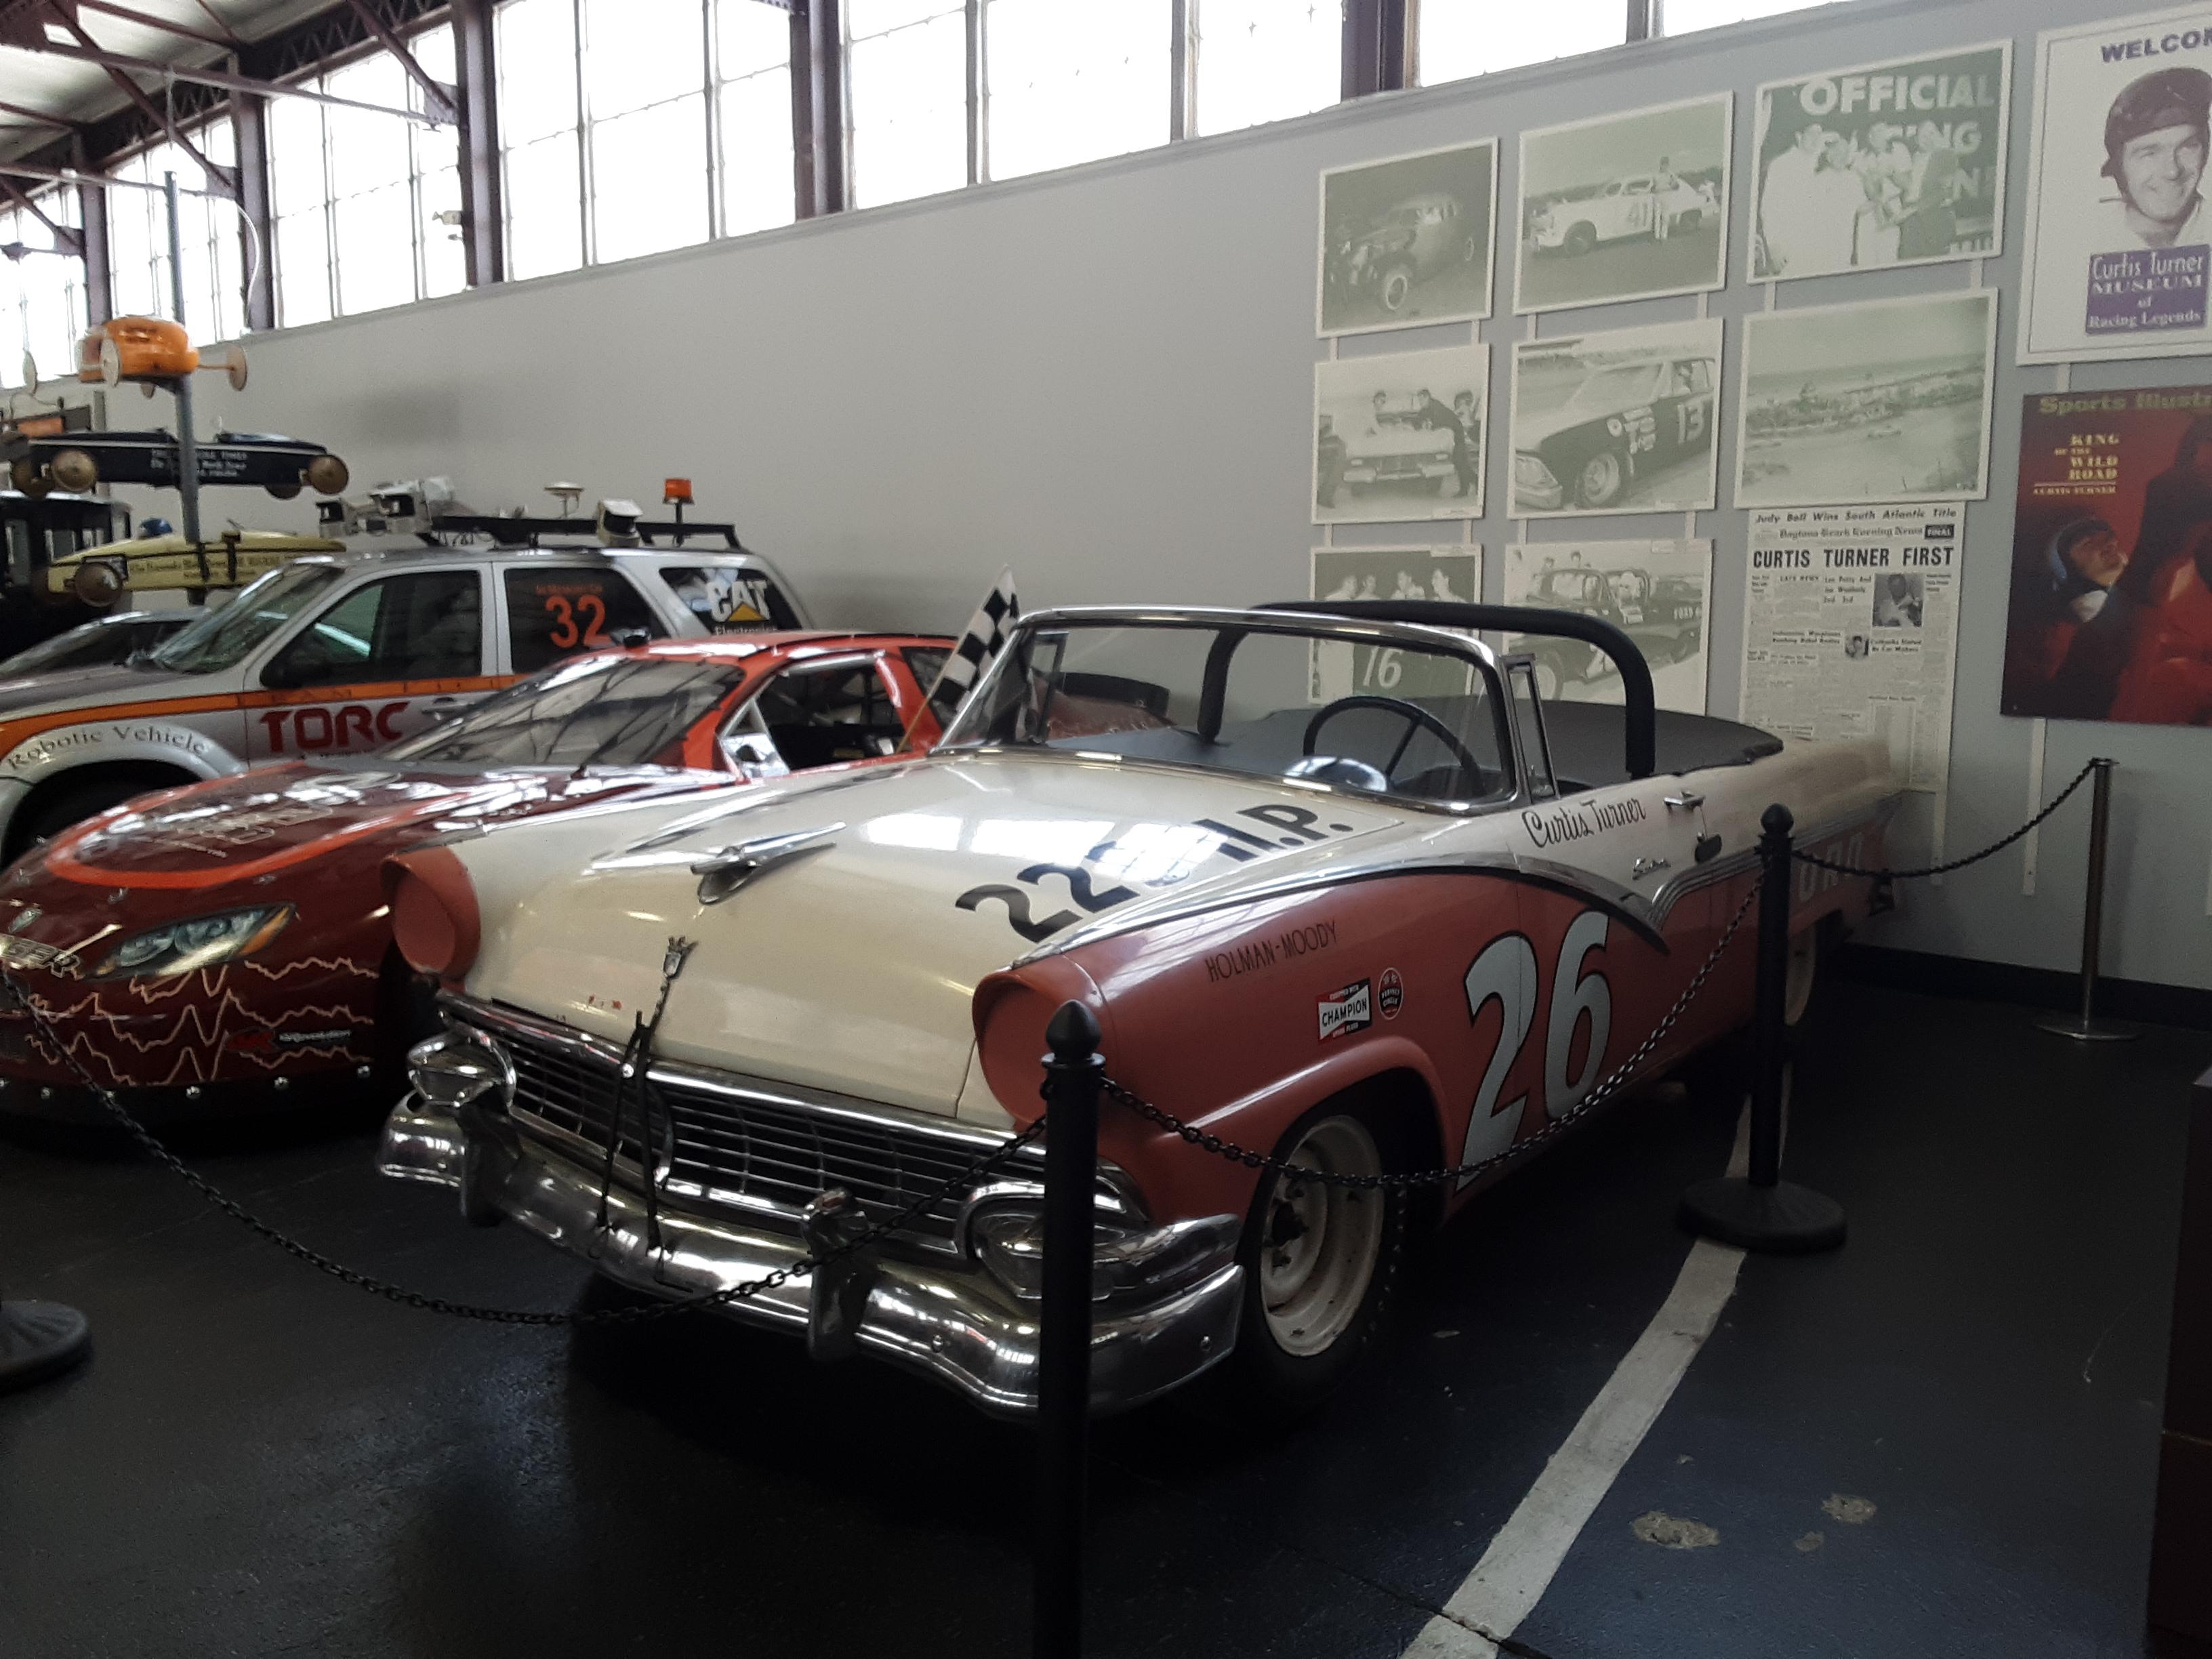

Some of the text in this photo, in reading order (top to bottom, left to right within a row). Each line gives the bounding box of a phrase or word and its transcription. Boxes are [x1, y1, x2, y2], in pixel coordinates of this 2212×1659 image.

[1800, 74, 1994, 115] OFFICIAL
[2093, 251, 2204, 281] Curtis Turner
[2092, 274, 2203, 294] MUSEUM
[2089, 309, 2201, 329] Racing Legends
[2070, 433, 2120, 445] KING
[2068, 468, 2118, 480] ROAD
[2070, 455, 2119, 467] WILD
[1755, 514, 1780, 524] Judy
[1813, 512, 1839, 521] Wins
[1845, 510, 1876, 520] South
[1882, 508, 1925, 519] Atlantic
[1933, 507, 1957, 518] Title
[1753, 547, 1954, 568] CURTIS TURNER FIRST
[706, 579, 770, 622] CAT
[545, 594, 610, 649] 32
[1362, 646, 1403, 689] 16
[260, 701, 410, 752] TORC
[8, 728, 104, 770] Robotic
[1521, 798, 1647, 848] Curtis Turner
[1204, 917, 1337, 982] HOLMAN-MOODY
[1322, 998, 1368, 1027] CHAMPION
[1454, 908, 1612, 1194] 26
